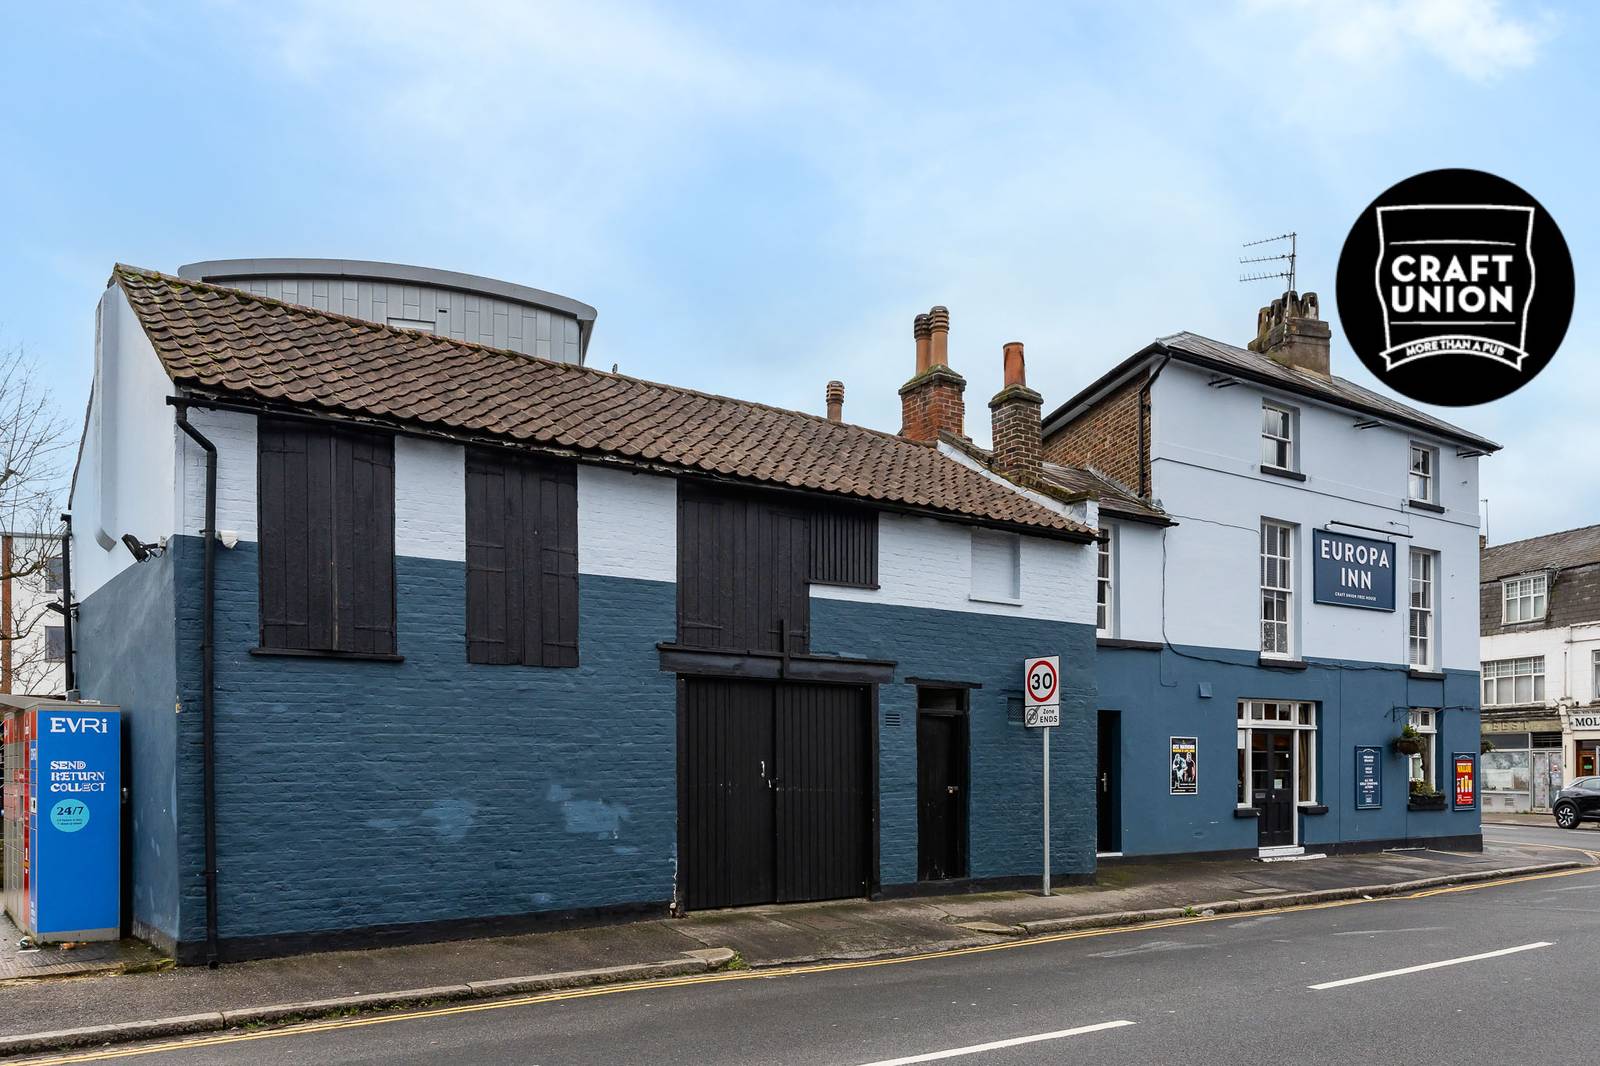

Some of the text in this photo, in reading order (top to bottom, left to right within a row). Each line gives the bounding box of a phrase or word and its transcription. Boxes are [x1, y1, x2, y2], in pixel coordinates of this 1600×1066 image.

[1321, 539, 1389, 568] EUROPA
[1341, 567, 1372, 590] INN
[1032, 673, 1052, 690] 30
[1039, 715, 1058, 723] ENDS
[1575, 717, 1600, 727] MOL
[50, 760, 87, 770] SEND
[50, 771, 105, 781] RETURN
[50, 782, 106, 792] COLLECT
[56, 806, 84, 816] 24/7
